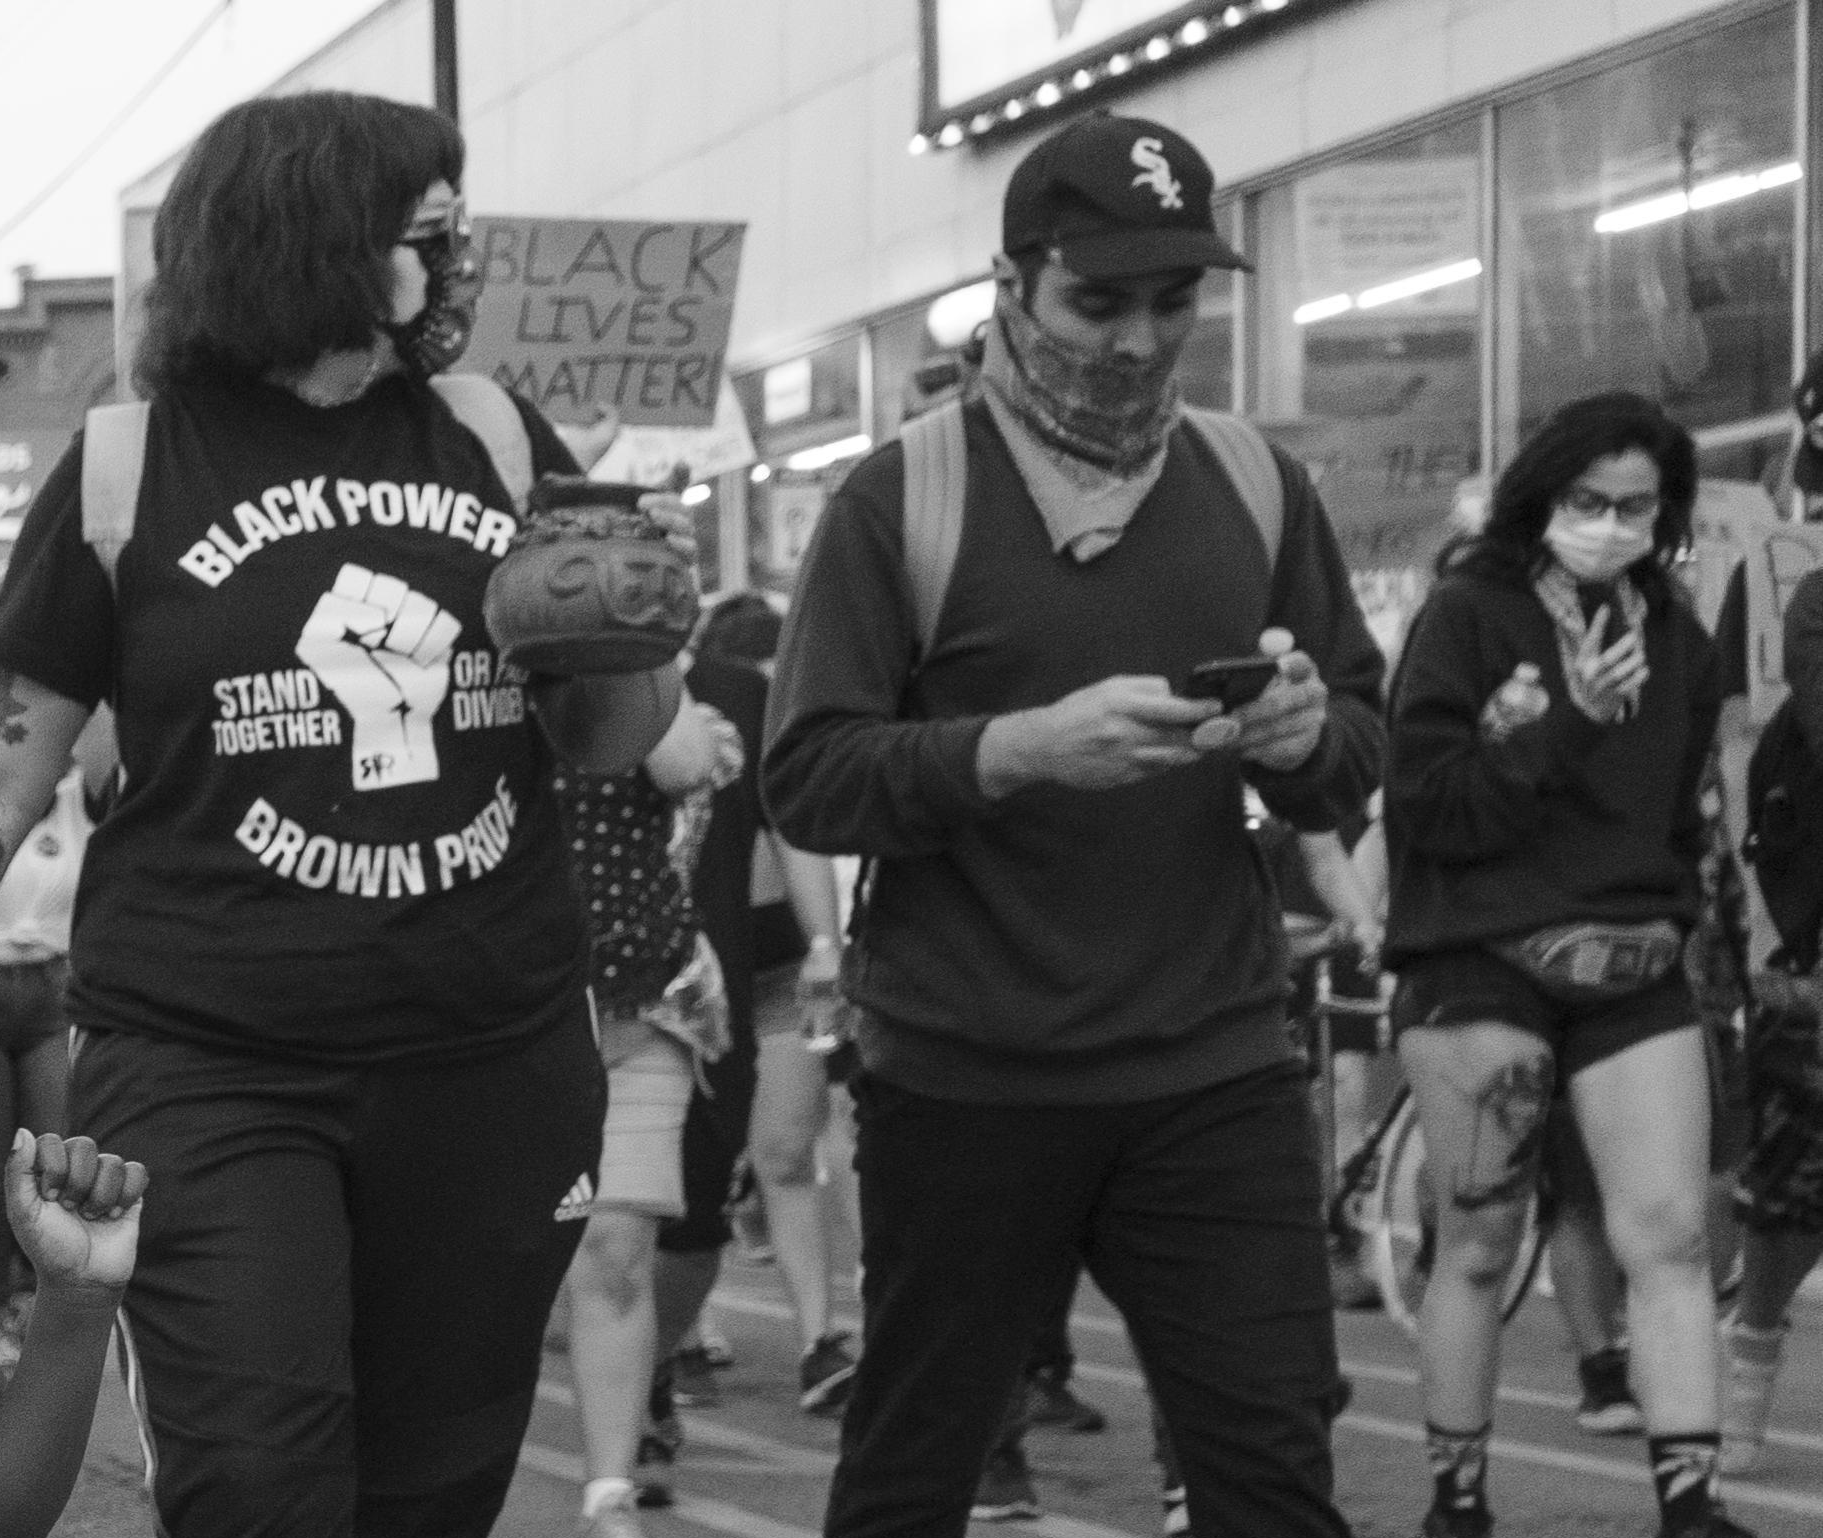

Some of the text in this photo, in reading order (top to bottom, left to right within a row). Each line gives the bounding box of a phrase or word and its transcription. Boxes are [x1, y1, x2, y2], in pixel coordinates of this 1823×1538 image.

[483, 223, 747, 294] BLACK
[516, 295, 706, 346] LIVES
[177, 475, 517, 588] BLACK POWER
[213, 669, 320, 718] STAND
[454, 650, 490, 688] OR
[211, 710, 341, 756] TOGETHER
[234, 772, 518, 899] BROWN PRIDE
